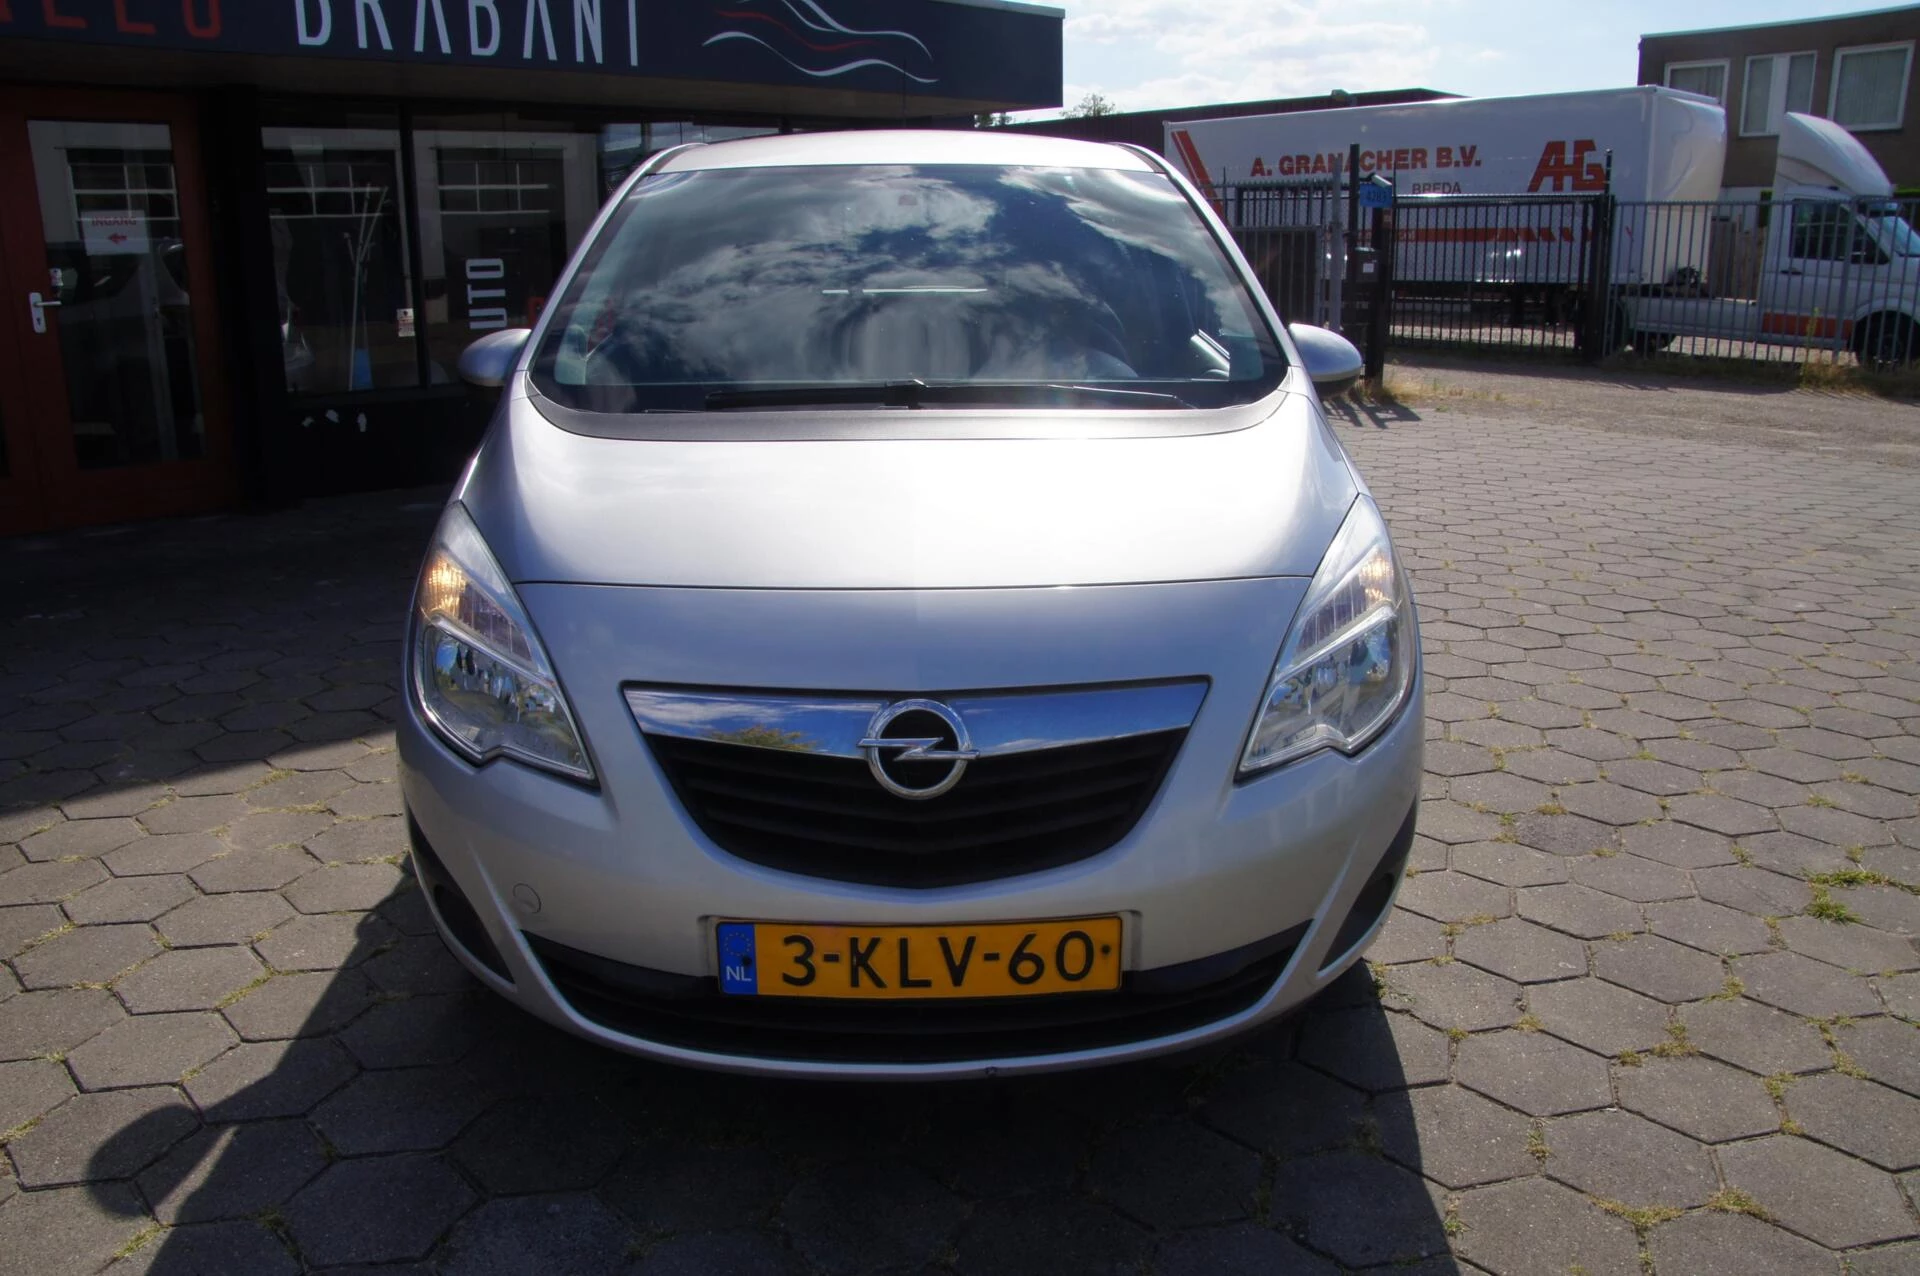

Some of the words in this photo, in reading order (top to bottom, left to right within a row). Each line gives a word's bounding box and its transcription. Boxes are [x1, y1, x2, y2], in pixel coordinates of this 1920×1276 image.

[1251, 156, 1272, 176] A.
[1436, 145, 1482, 168] B.V.
[725, 964, 752, 982] NL
[781, 931, 1095, 989] 3-KLV-60
